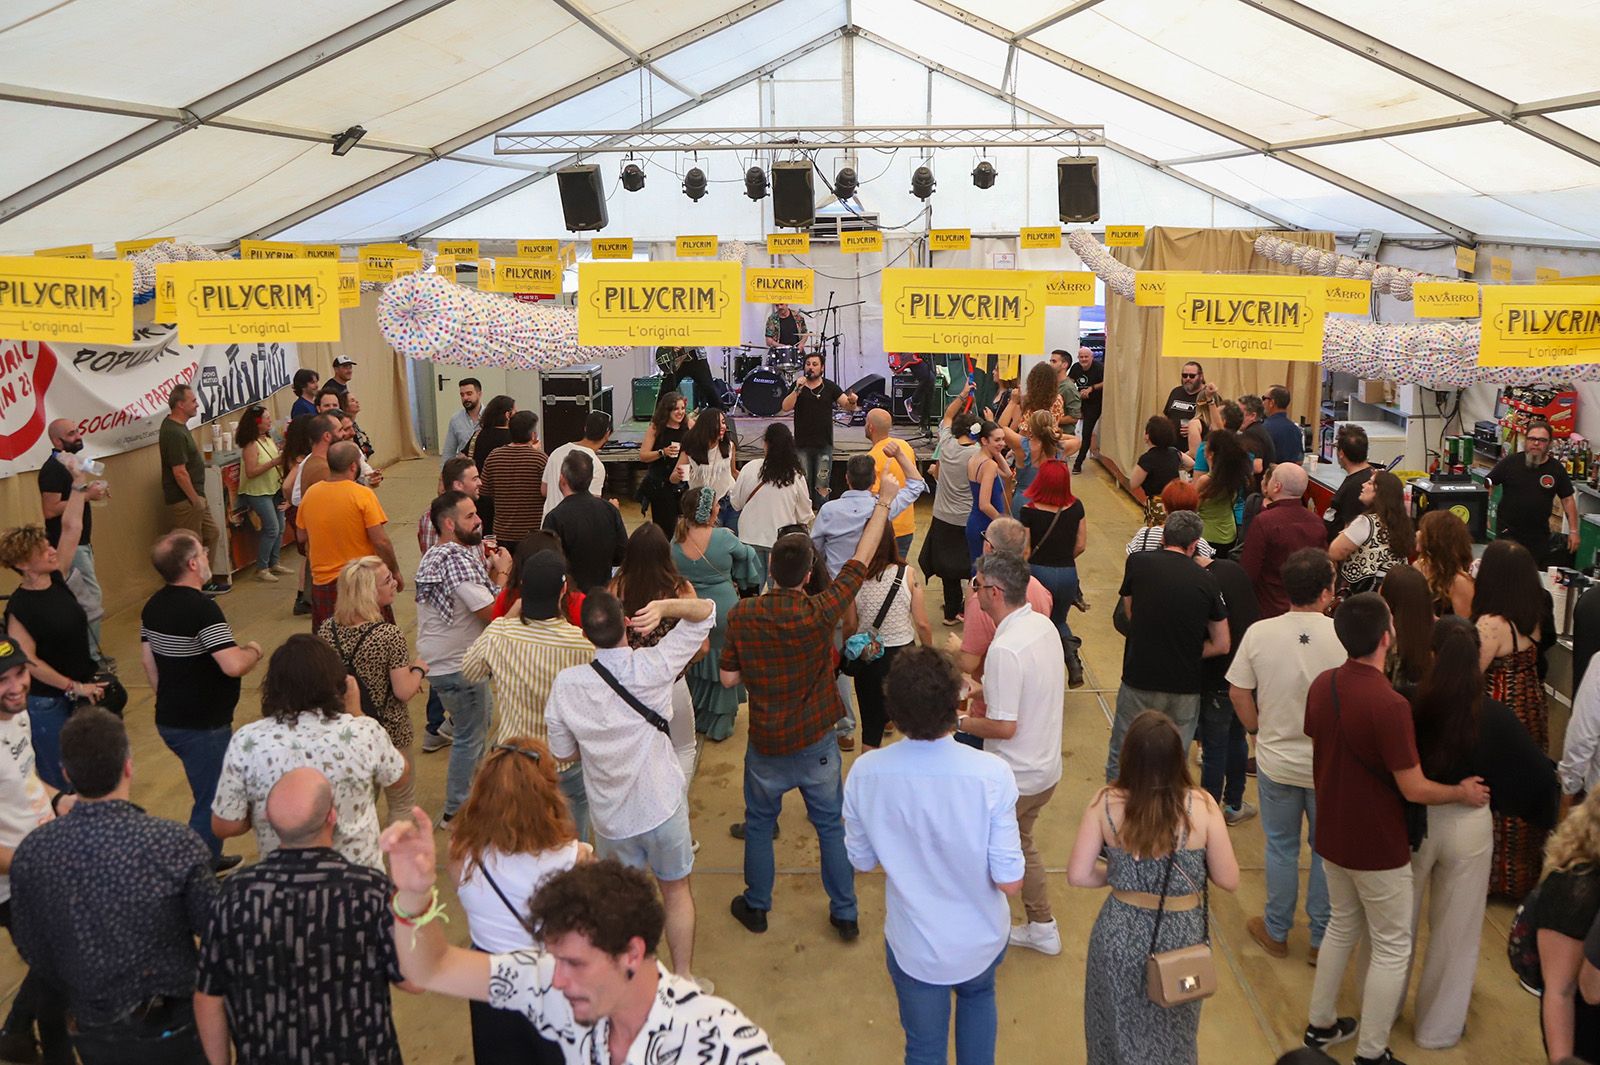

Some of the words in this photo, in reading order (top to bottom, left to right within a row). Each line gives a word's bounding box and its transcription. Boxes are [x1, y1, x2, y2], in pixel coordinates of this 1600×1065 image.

[936, 233, 966, 242] PILYCRIM
[1027, 232, 1056, 240] PILYCRIM
[1111, 230, 1139, 238] PILYCRIM
[599, 243, 628, 251] PILYCRIM
[683, 241, 712, 249] PILYCRIM
[774, 238, 803, 246] PILYCRIM
[847, 237, 876, 245] PILYCRIM
[308, 250, 335, 258] PILYCRIM
[445, 247, 473, 255] PILYCRIM
[524, 245, 553, 253] PILYCRIM
[506, 267, 551, 280] PILYCRIM
[756, 277, 803, 290] PILYCRIM
[202, 284, 314, 311] PILYCRIM
[605, 286, 716, 312] PILYCRIM
[910, 293, 1021, 321] PILYCRIM
[1191, 299, 1301, 327] PILYCRIM
[22, 320, 84, 336] L'original
[229, 322, 290, 336] L'original
[628, 325, 690, 340] L'original
[933, 332, 994, 347] L'original
[1212, 338, 1272, 352] L'original
[1528, 344, 1578, 360] L'original
